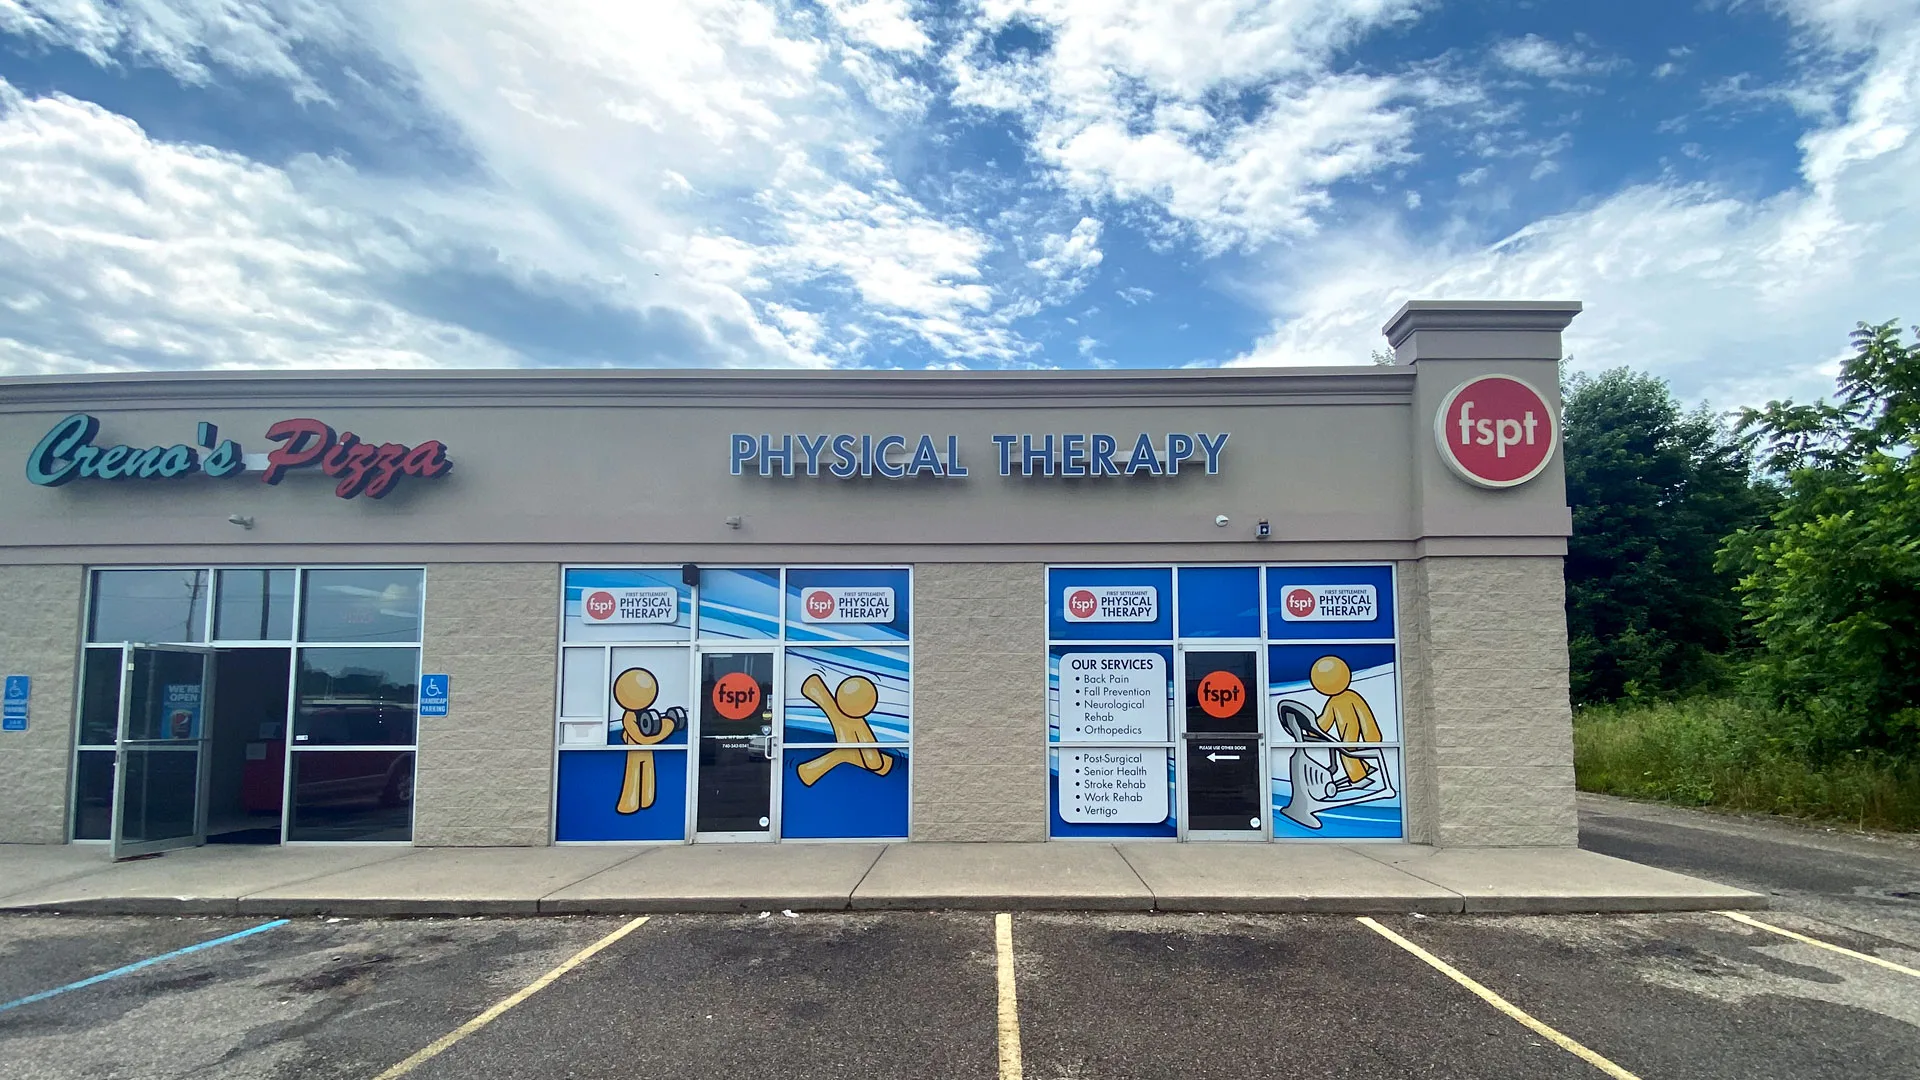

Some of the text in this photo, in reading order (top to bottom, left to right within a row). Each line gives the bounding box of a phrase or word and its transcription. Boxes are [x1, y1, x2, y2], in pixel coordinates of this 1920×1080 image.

[1459, 401, 1538, 458] fspt
[26, 413, 450, 499] Creno's Pizza
[729, 433, 1231, 479] PHYSICAL THERAPY
[620, 598, 672, 607] PHYSICAL
[809, 597, 832, 613] fspt
[839, 597, 890, 607] PHYSICAL
[1071, 596, 1094, 612] fspt
[1101, 596, 1152, 606] PHYSICAL
[1289, 595, 1312, 611] fspt
[1319, 595, 1371, 605] PHYSICAL
[590, 598, 613, 614] fspt
[1320, 606, 1371, 616] THERAPY
[620, 608, 671, 618] THERAPY
[839, 608, 889, 618] THERAPY
[1102, 607, 1151, 617] THERAPY
[1071, 659, 1153, 670] OUR SERVICES
[1084, 674, 1129, 684] Back Pain
[718, 683, 755, 709] fspt
[1084, 686, 1151, 696] Fall Prevention
[1203, 681, 1240, 707] fspt
[170, 694, 198, 702] OPEN
[421, 705, 446, 713] PARKING
[1084, 699, 1145, 711] Neurological
[1084, 712, 1114, 722] Rehab
[1084, 724, 1142, 736] Orthopedics
[1083, 753, 1142, 765] Post-Surgical
[1084, 766, 1147, 776] Senior Health
[1084, 779, 1146, 789] Stroke Rehab
[1084, 792, 1143, 802] Work Rehab
[1084, 805, 1118, 817] Vertigo
